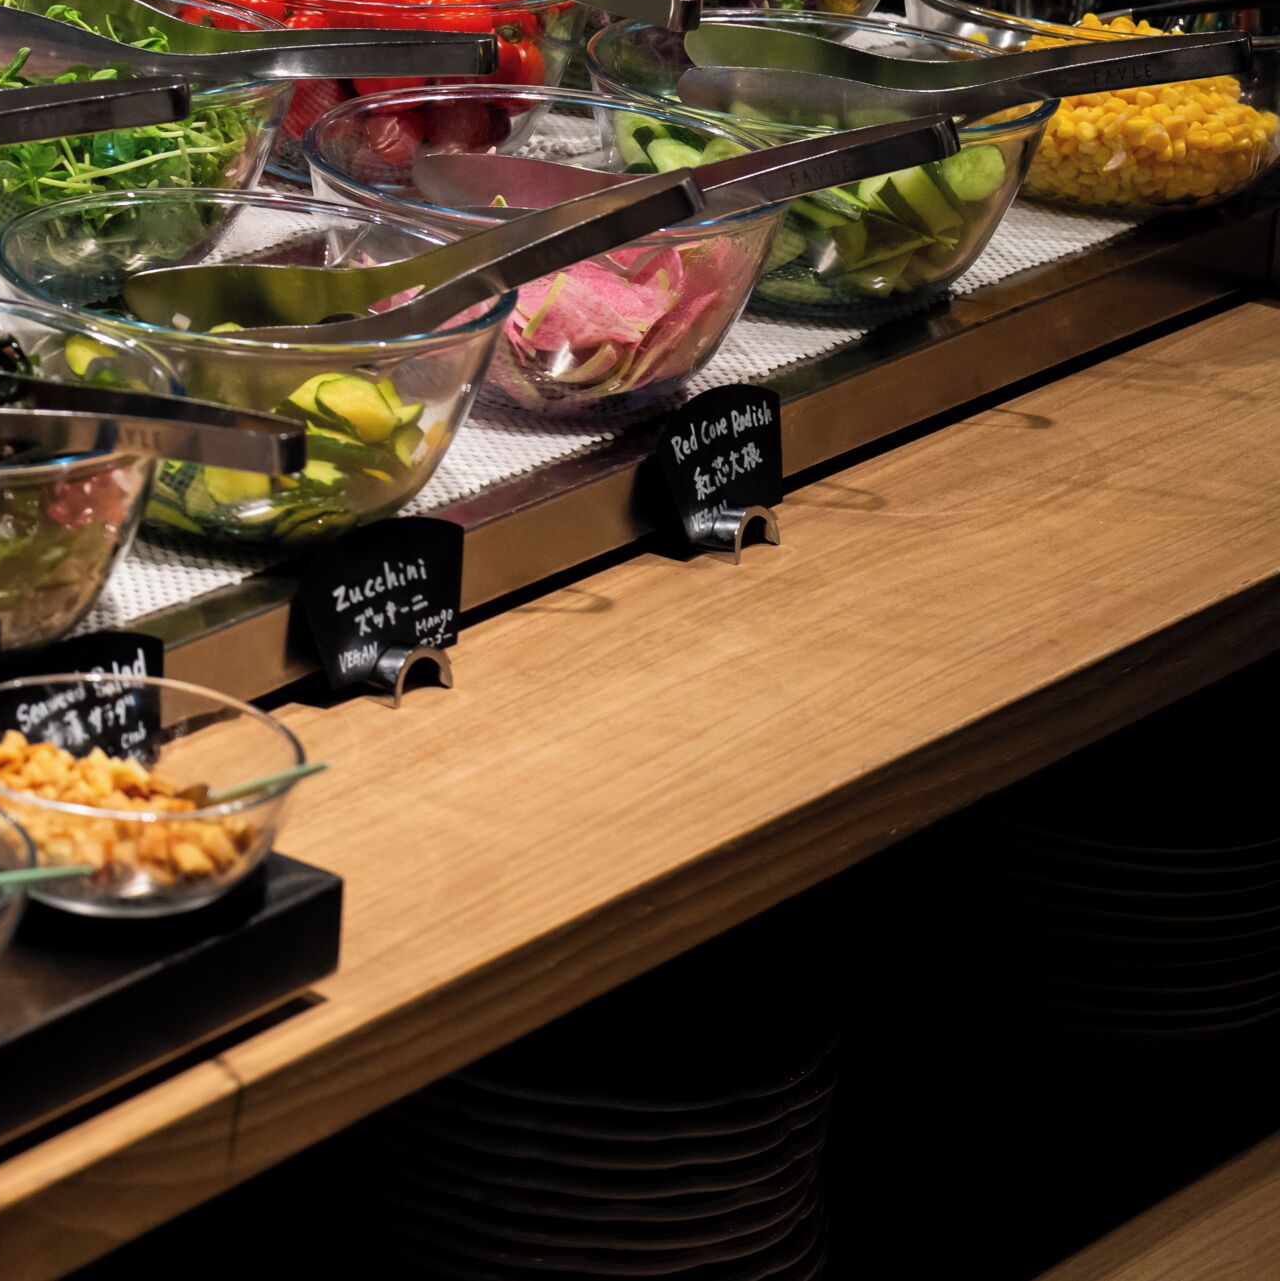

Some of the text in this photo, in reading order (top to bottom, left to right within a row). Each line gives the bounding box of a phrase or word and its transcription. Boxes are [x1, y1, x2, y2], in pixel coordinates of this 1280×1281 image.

[670, 422, 699, 466] Red
[700, 417, 728, 445] Core
[332, 558, 428, 613] Zucchini
[353, 593, 429, 638] ズッキーニ
[414, 608, 454, 637] Mango
[337, 640, 379, 675] VEGAN
